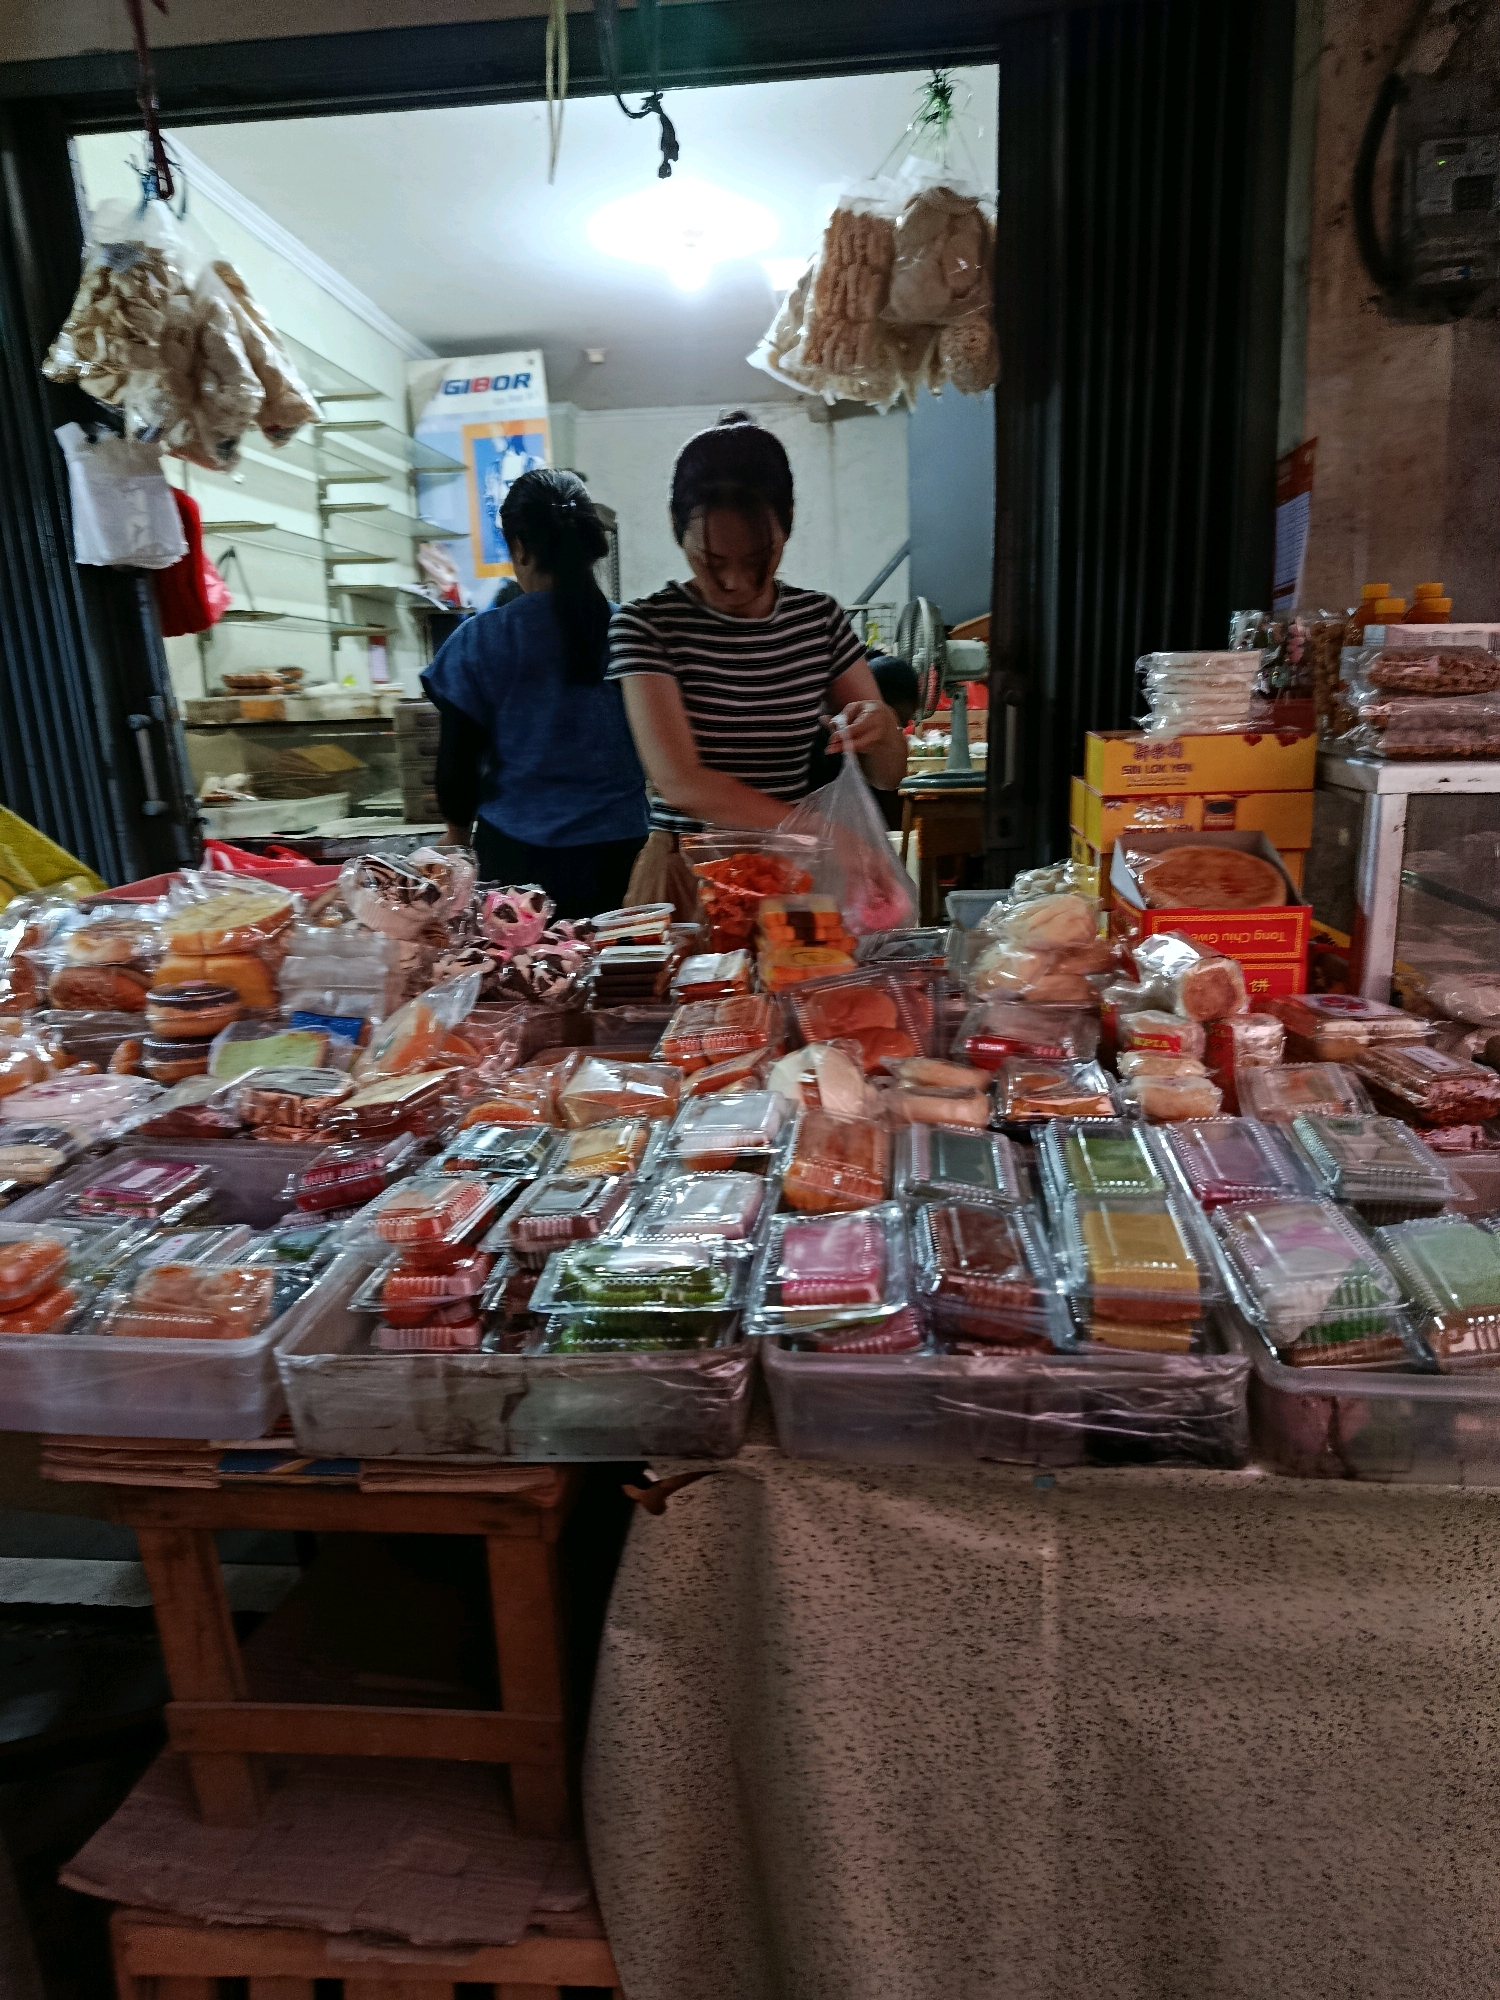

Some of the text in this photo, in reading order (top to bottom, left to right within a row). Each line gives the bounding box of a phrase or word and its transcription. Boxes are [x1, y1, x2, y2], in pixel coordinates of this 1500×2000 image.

[443, 372, 532, 395] GIBOR
[1222, 931, 1251, 944] Chiu
[1253, 929, 1287, 943] Tong
